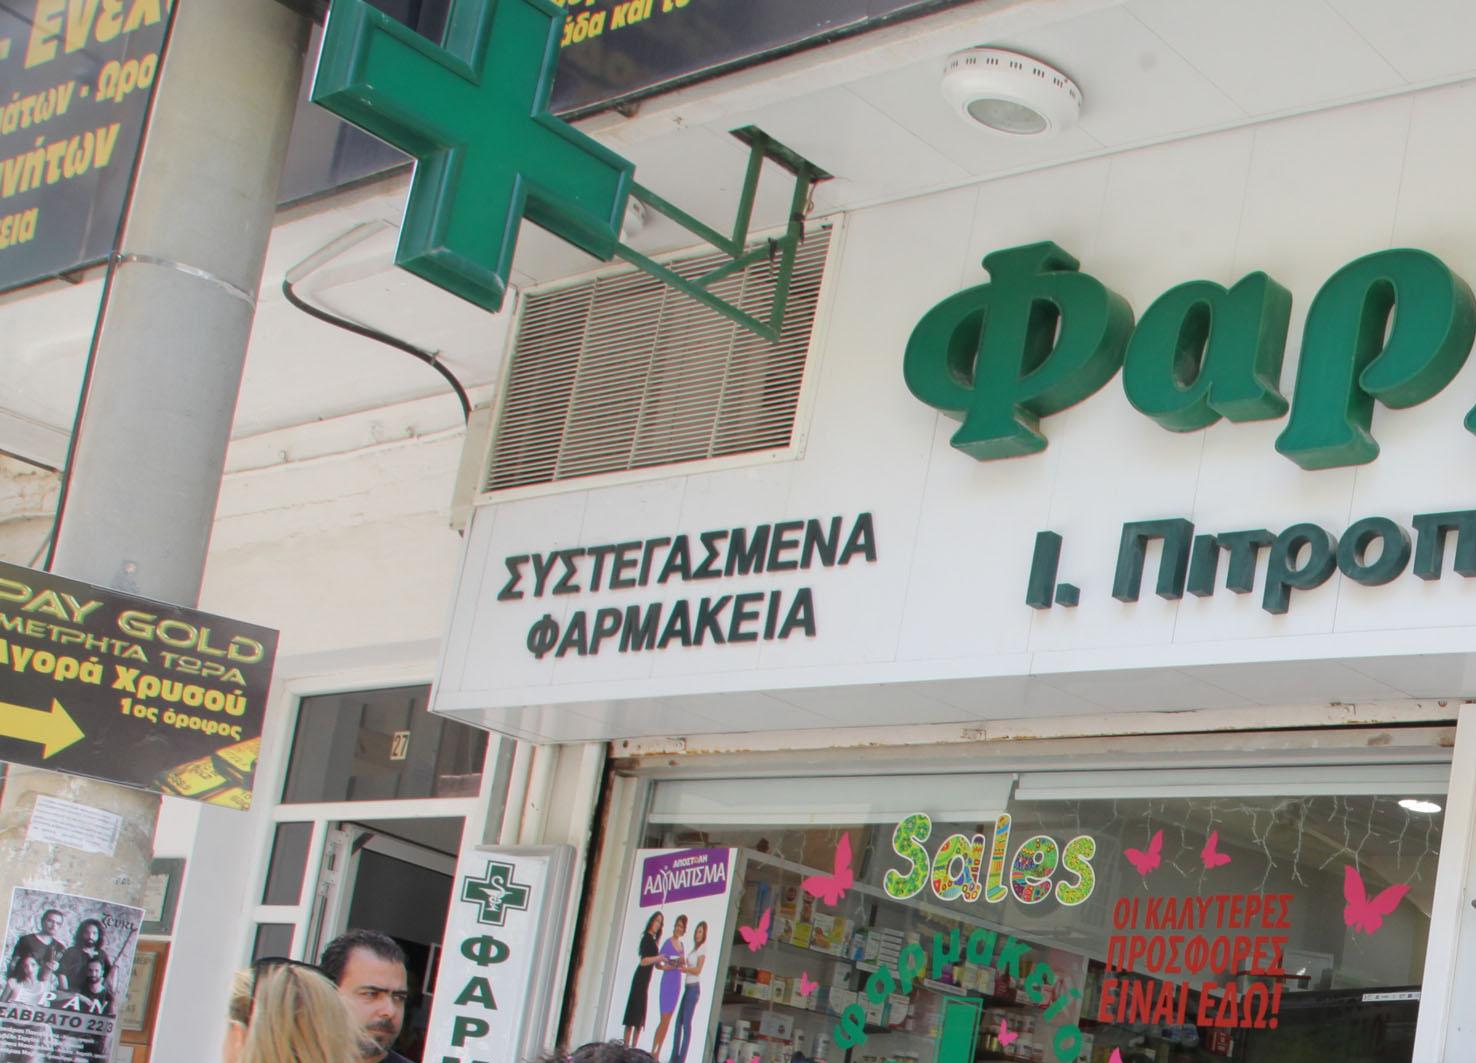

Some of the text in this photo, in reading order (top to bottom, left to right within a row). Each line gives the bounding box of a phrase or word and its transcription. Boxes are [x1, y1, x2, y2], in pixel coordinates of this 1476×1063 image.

[497, 510, 878, 602] ΣΥΣΤΕΓΑΣΜΕΝΑ
[117, 609, 265, 665] GOLD
[526, 587, 817, 660] ΦΑΡΜΑΚΕΙΑ
[160, 651, 248, 687] ΤΩΡΑ
[163, 711, 243, 742] όροφος
[643, 862, 726, 900] ΑΔΥΝΑΤΙΣΜΑ
[883, 811, 1098, 906] Sales
[1112, 893, 1294, 931] ΟΙ ΚΑΛΥΤΕΡΕΣ
[1105, 935, 1290, 977] ΠΡΟΣΦΟΡΕΣ
[1098, 978, 1283, 1030] ΕΙΝΑΙ ΕΔΩ!
